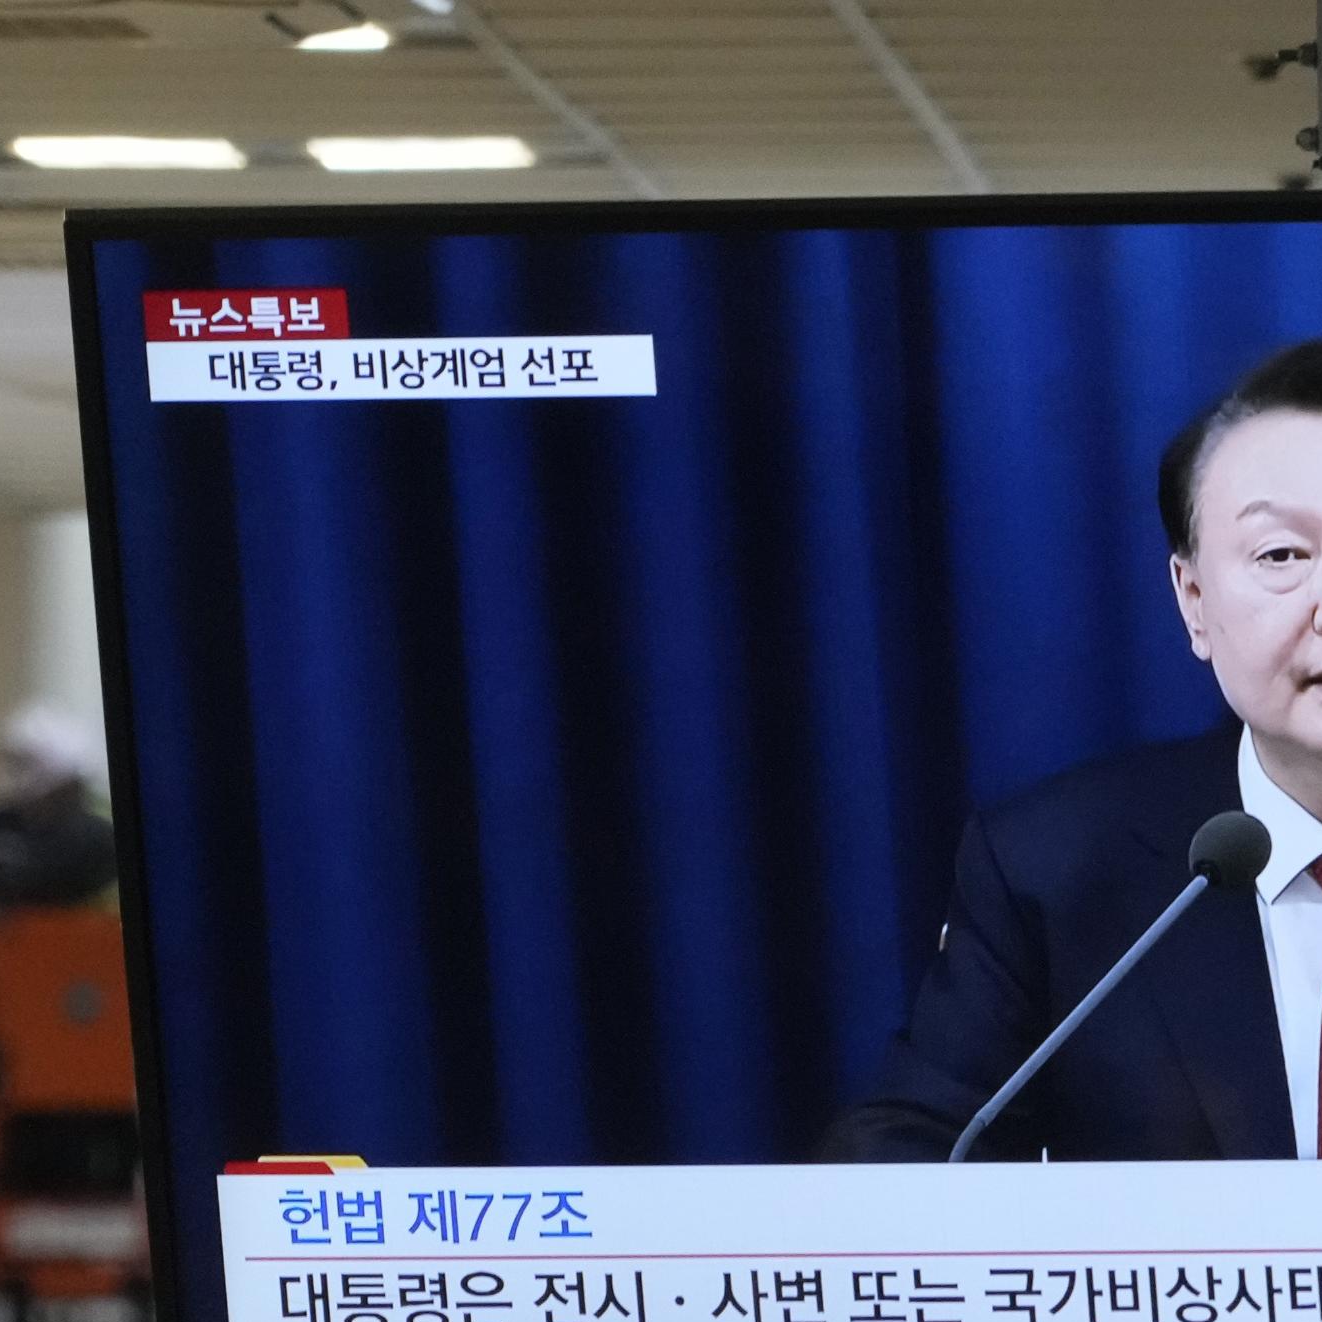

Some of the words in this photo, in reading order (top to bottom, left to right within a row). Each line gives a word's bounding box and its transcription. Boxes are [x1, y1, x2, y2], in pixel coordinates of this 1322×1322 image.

[169, 297, 326, 336] 뉴스특보
[209, 350, 337, 391] 대통령,
[353, 348, 505, 389] 비상계엄
[521, 347, 598, 386] 선포
[279, 1190, 385, 1244] 헌법
[408, 1190, 592, 1244] 제77조
